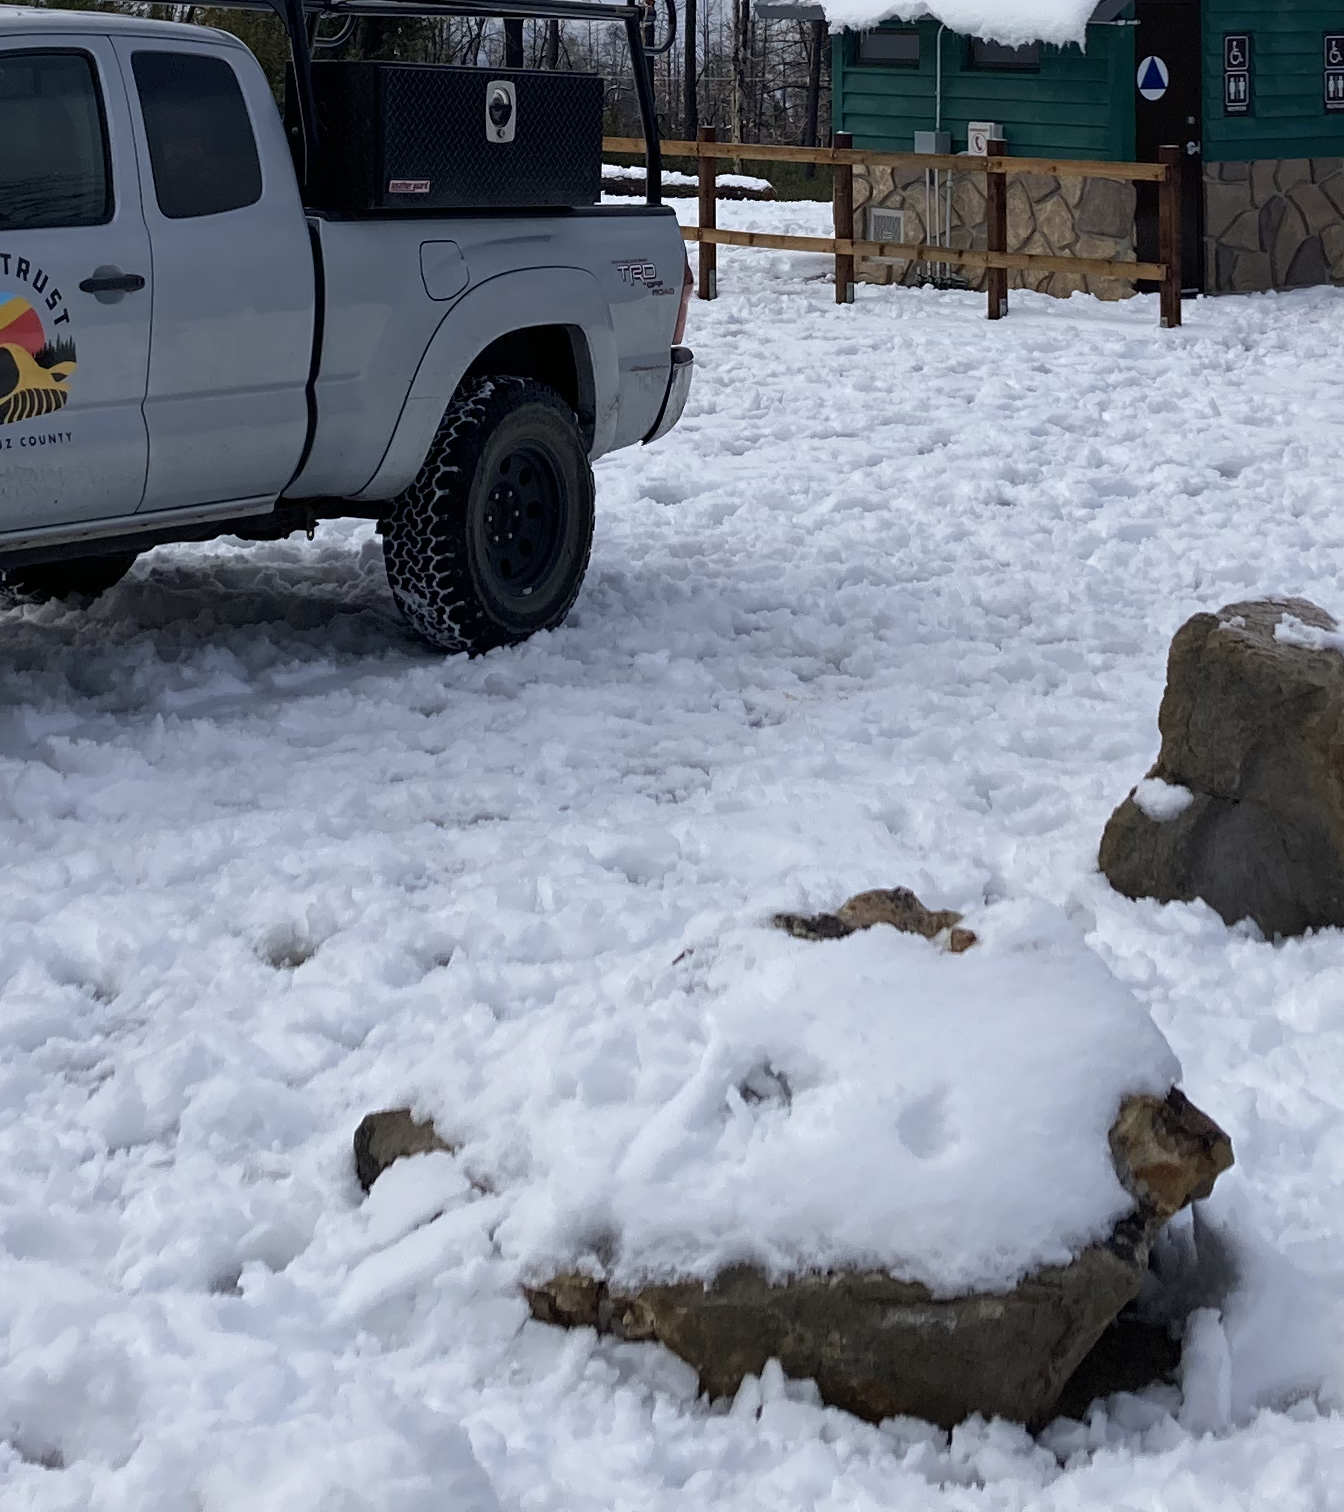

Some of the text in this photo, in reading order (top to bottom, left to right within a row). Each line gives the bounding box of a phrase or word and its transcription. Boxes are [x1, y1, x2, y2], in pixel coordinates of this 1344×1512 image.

[616, 263, 657, 286] TRD
[0, 253, 71, 326] TRUST
[20, 432, 72, 448] COUNTY
